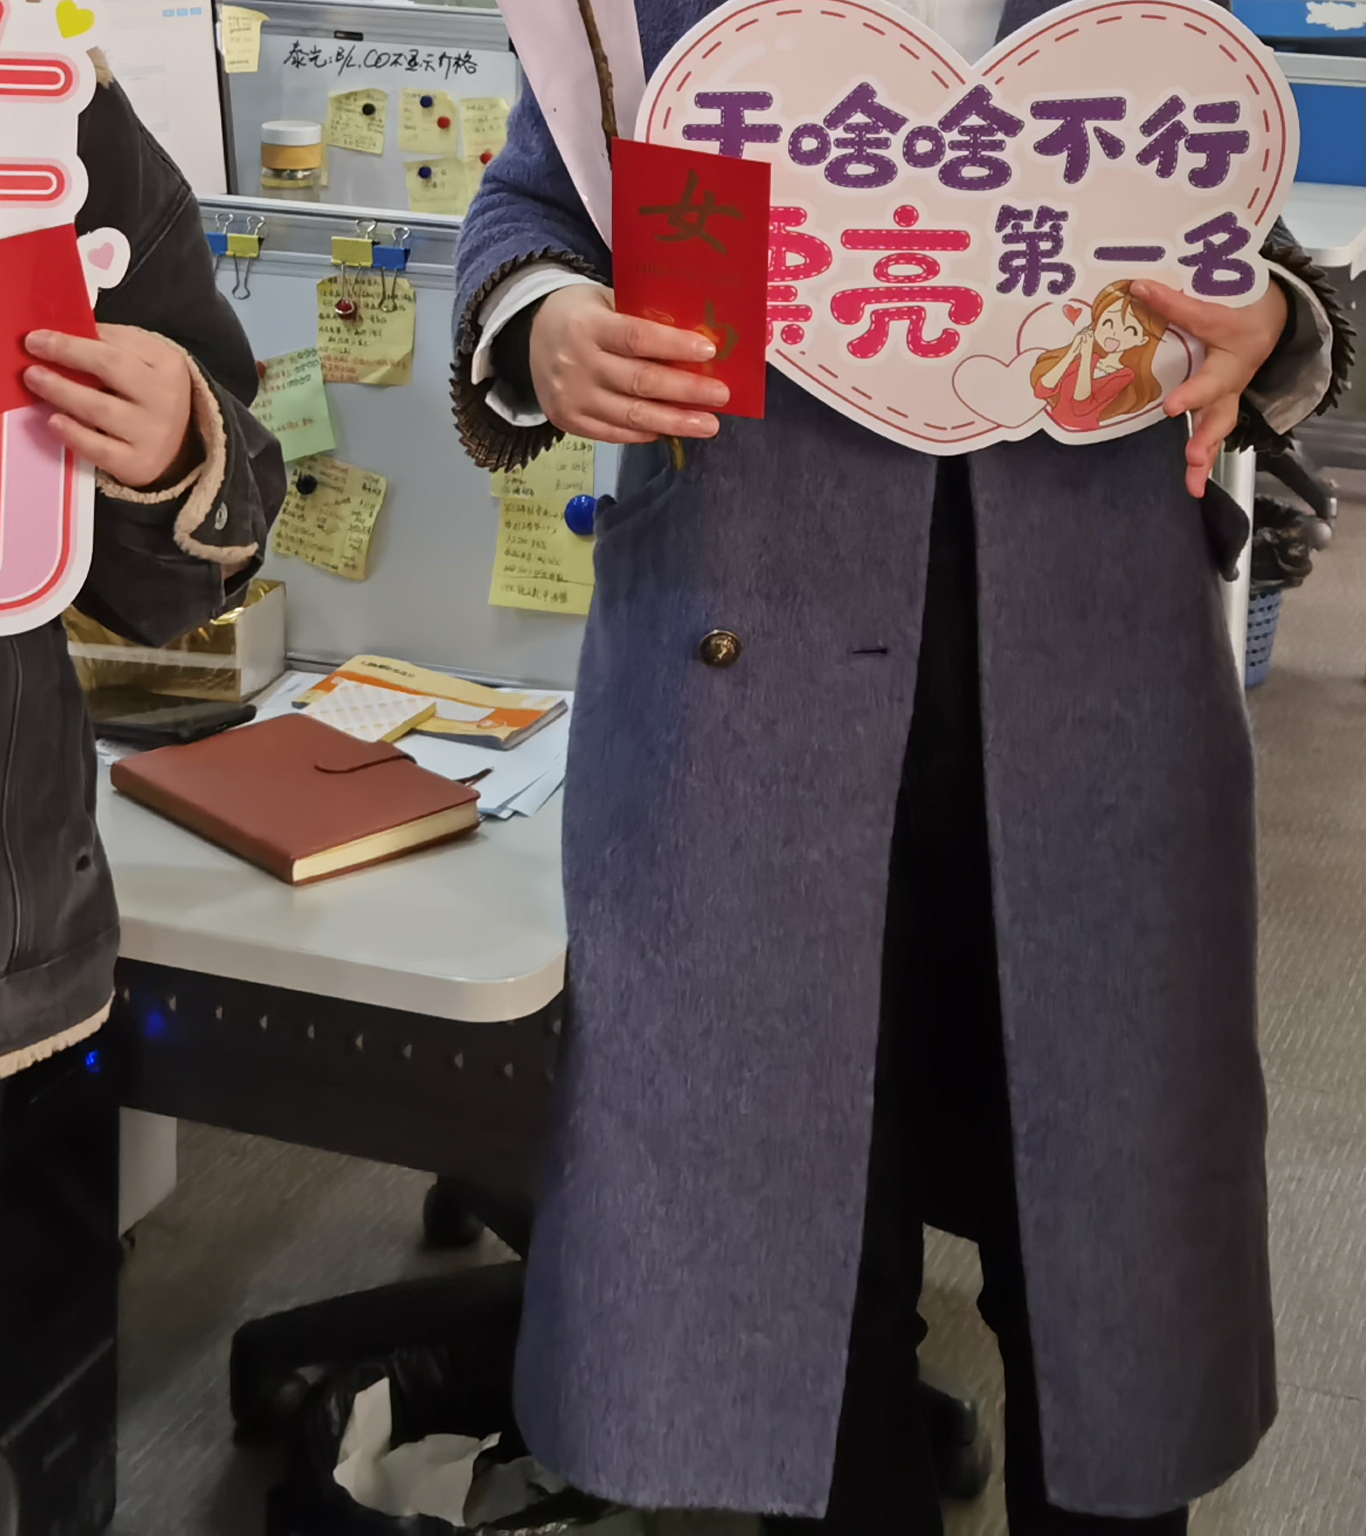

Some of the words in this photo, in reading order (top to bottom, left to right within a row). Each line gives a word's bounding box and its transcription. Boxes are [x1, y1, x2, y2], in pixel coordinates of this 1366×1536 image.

[680, 80, 1251, 192] 干啥啥不行
